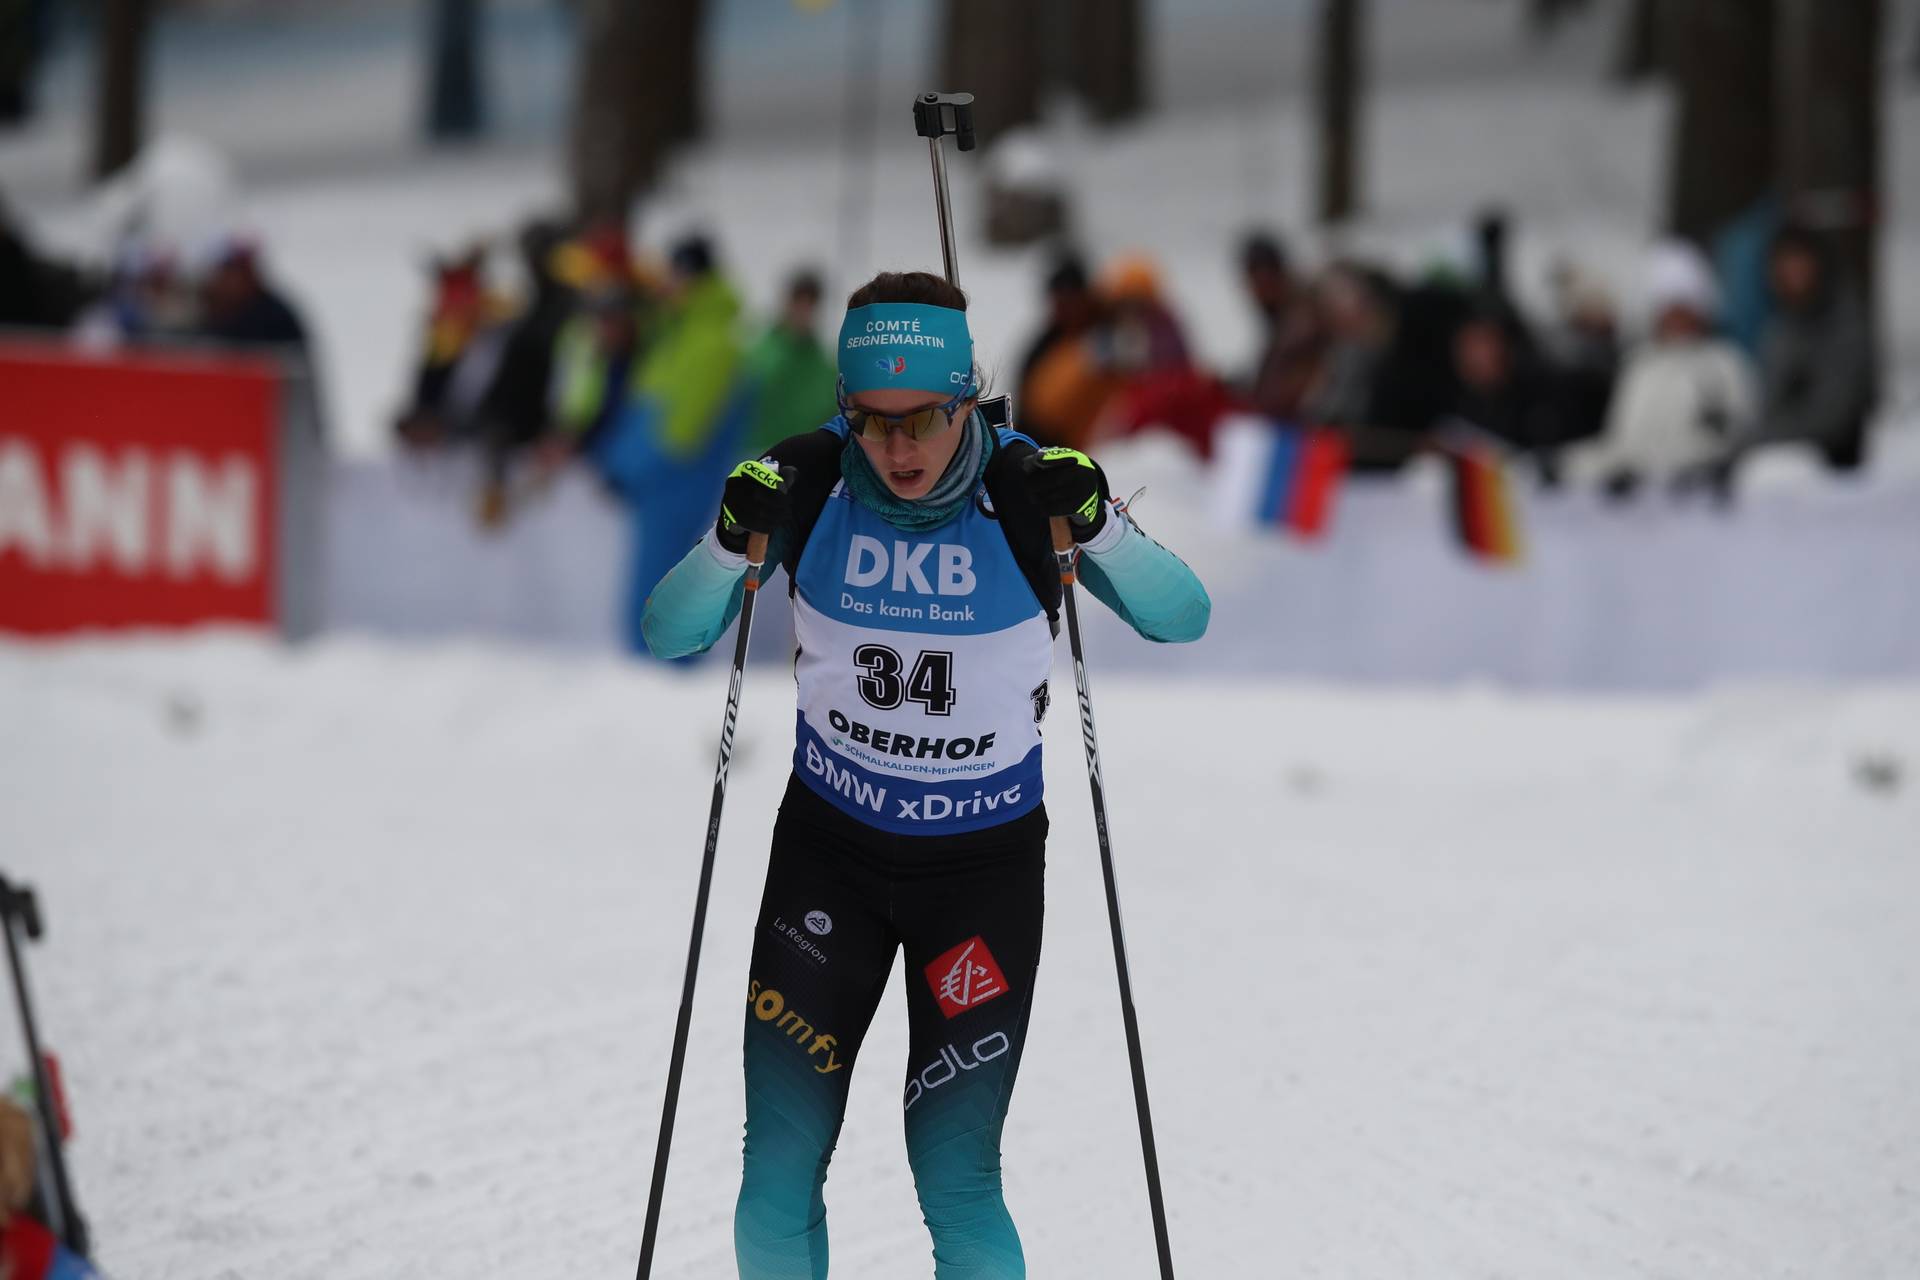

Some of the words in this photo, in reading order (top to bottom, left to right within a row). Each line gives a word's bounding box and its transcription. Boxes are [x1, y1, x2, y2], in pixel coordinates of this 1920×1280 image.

[847, 333, 945, 349] SEIGNEMARTIN
[866, 318, 921, 333] COMTÉ
[844, 534, 977, 597] DKB
[840, 592, 873, 615] Das
[879, 598, 923, 620] kann
[928, 604, 976, 622] Bank
[853, 643, 957, 717] 34
[828, 709, 996, 761] OBERHOF
[844, 743, 996, 775] SCHMALKALDEN-MEININGEN
[805, 739, 887, 813] BMW
[896, 783, 1022, 821] xDrive
[774, 916, 787, 932] La
[786, 927, 827, 964] Région
[748, 980, 842, 1074] somfy
[904, 1031, 1010, 1111] odlo
